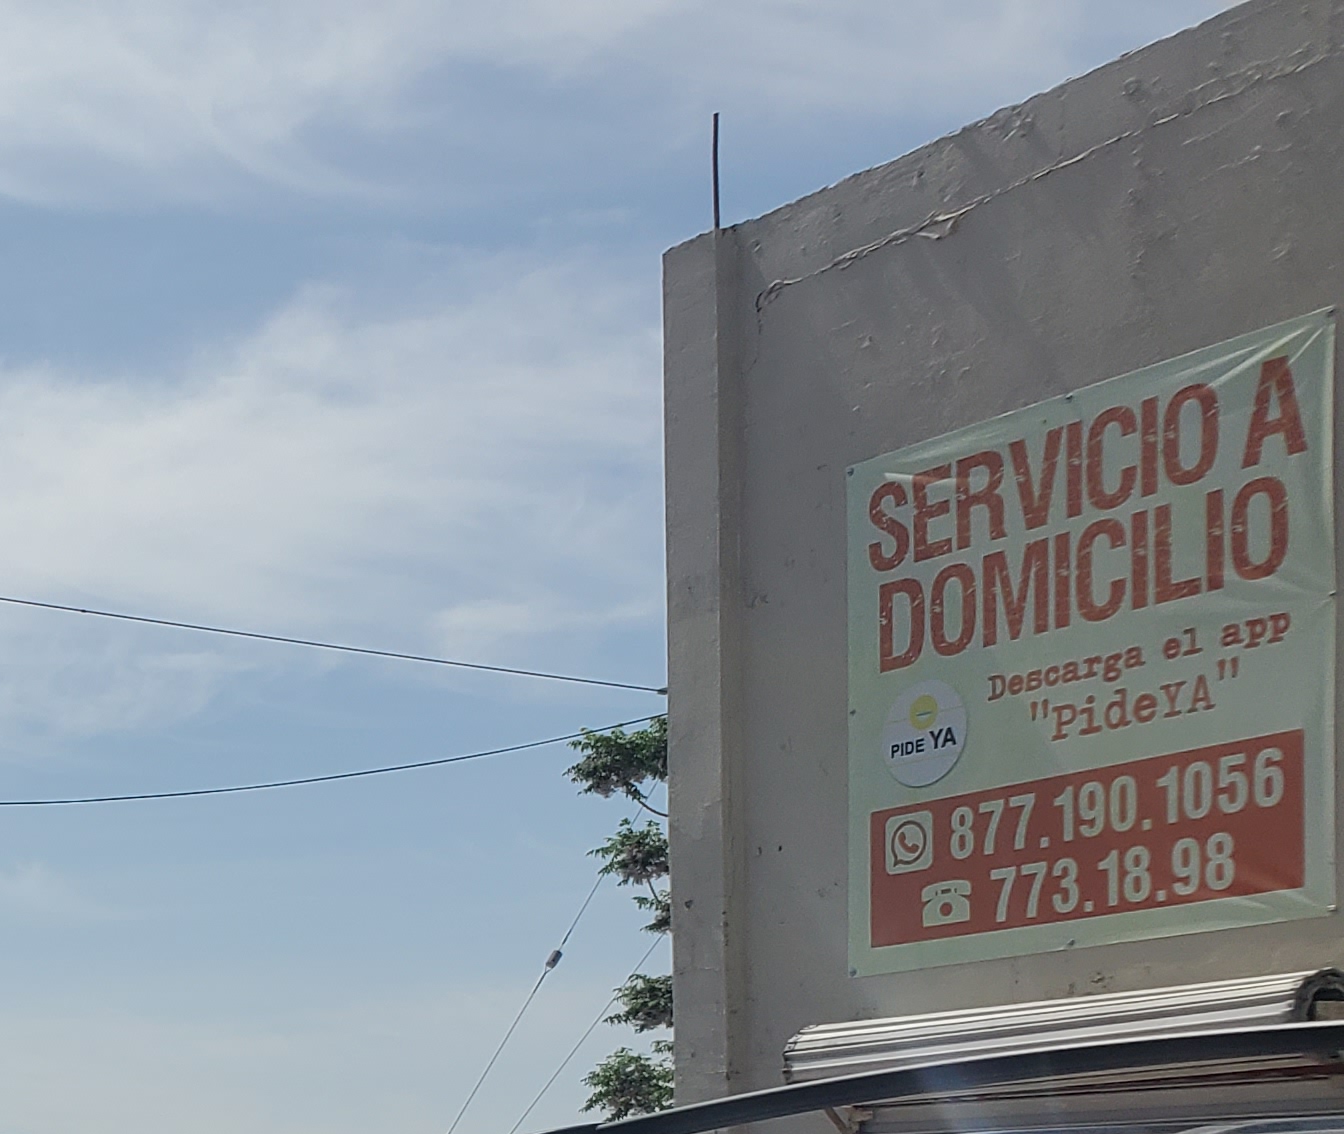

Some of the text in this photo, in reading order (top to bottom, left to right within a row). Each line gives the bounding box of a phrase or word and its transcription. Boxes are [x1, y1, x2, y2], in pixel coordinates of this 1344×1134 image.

[868, 355, 1308, 571] SERVICIO A
[879, 476, 1289, 673] DOMICILIO
[987, 612, 1291, 701] Descarga el app
[1029, 656, 1240, 741] "PideYA"
[890, 726, 957, 759] PIDE YA
[950, 748, 1284, 860] 877.190.1056
[990, 832, 1235, 923] 773.18.98
